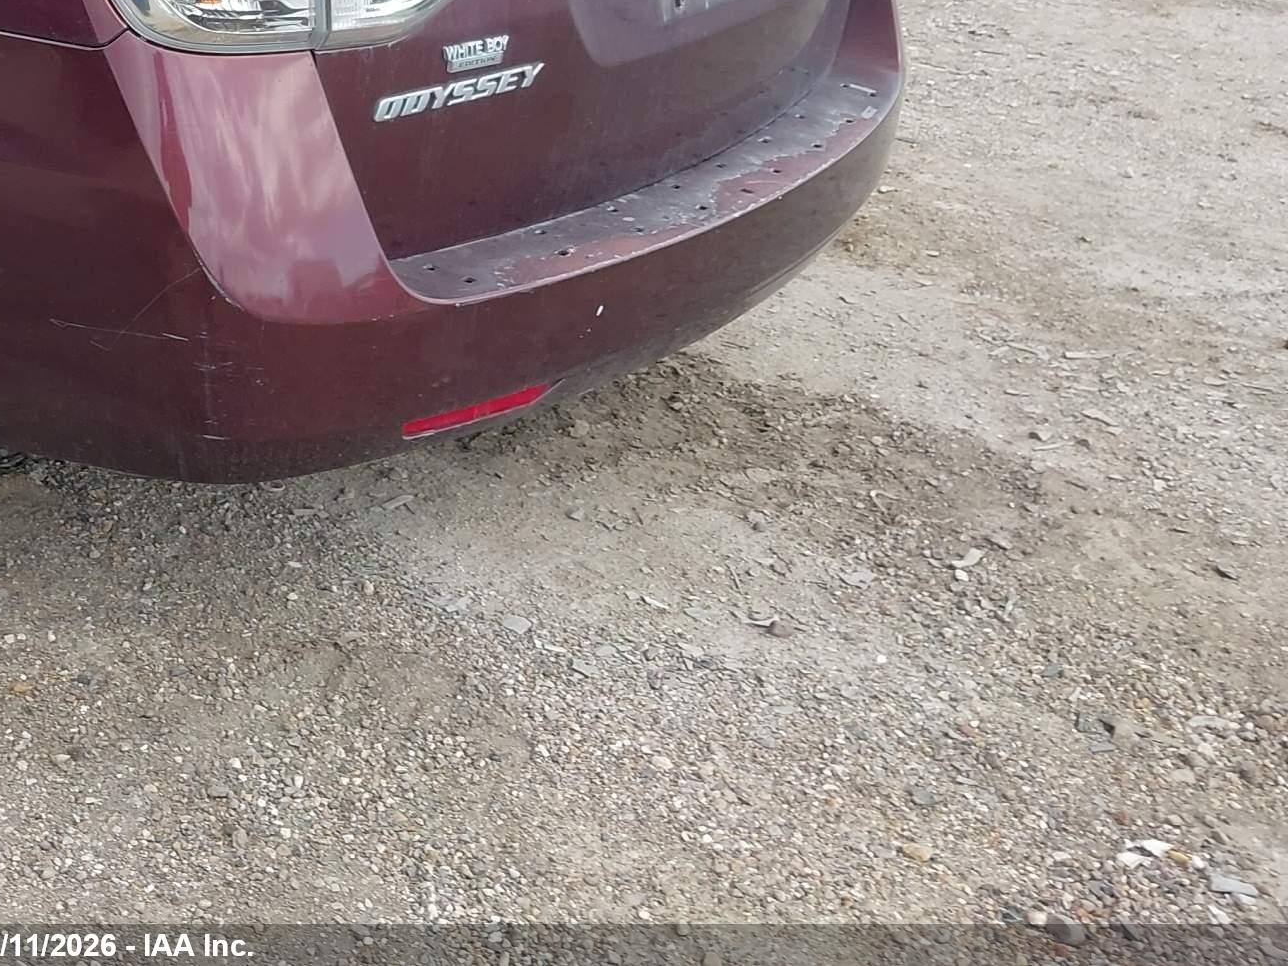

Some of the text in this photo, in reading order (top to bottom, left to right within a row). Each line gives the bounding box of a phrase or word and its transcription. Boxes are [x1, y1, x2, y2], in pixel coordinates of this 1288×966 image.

[442, 35, 510, 62] WHITE BOY
[374, 63, 545, 122] ODYSSEY
